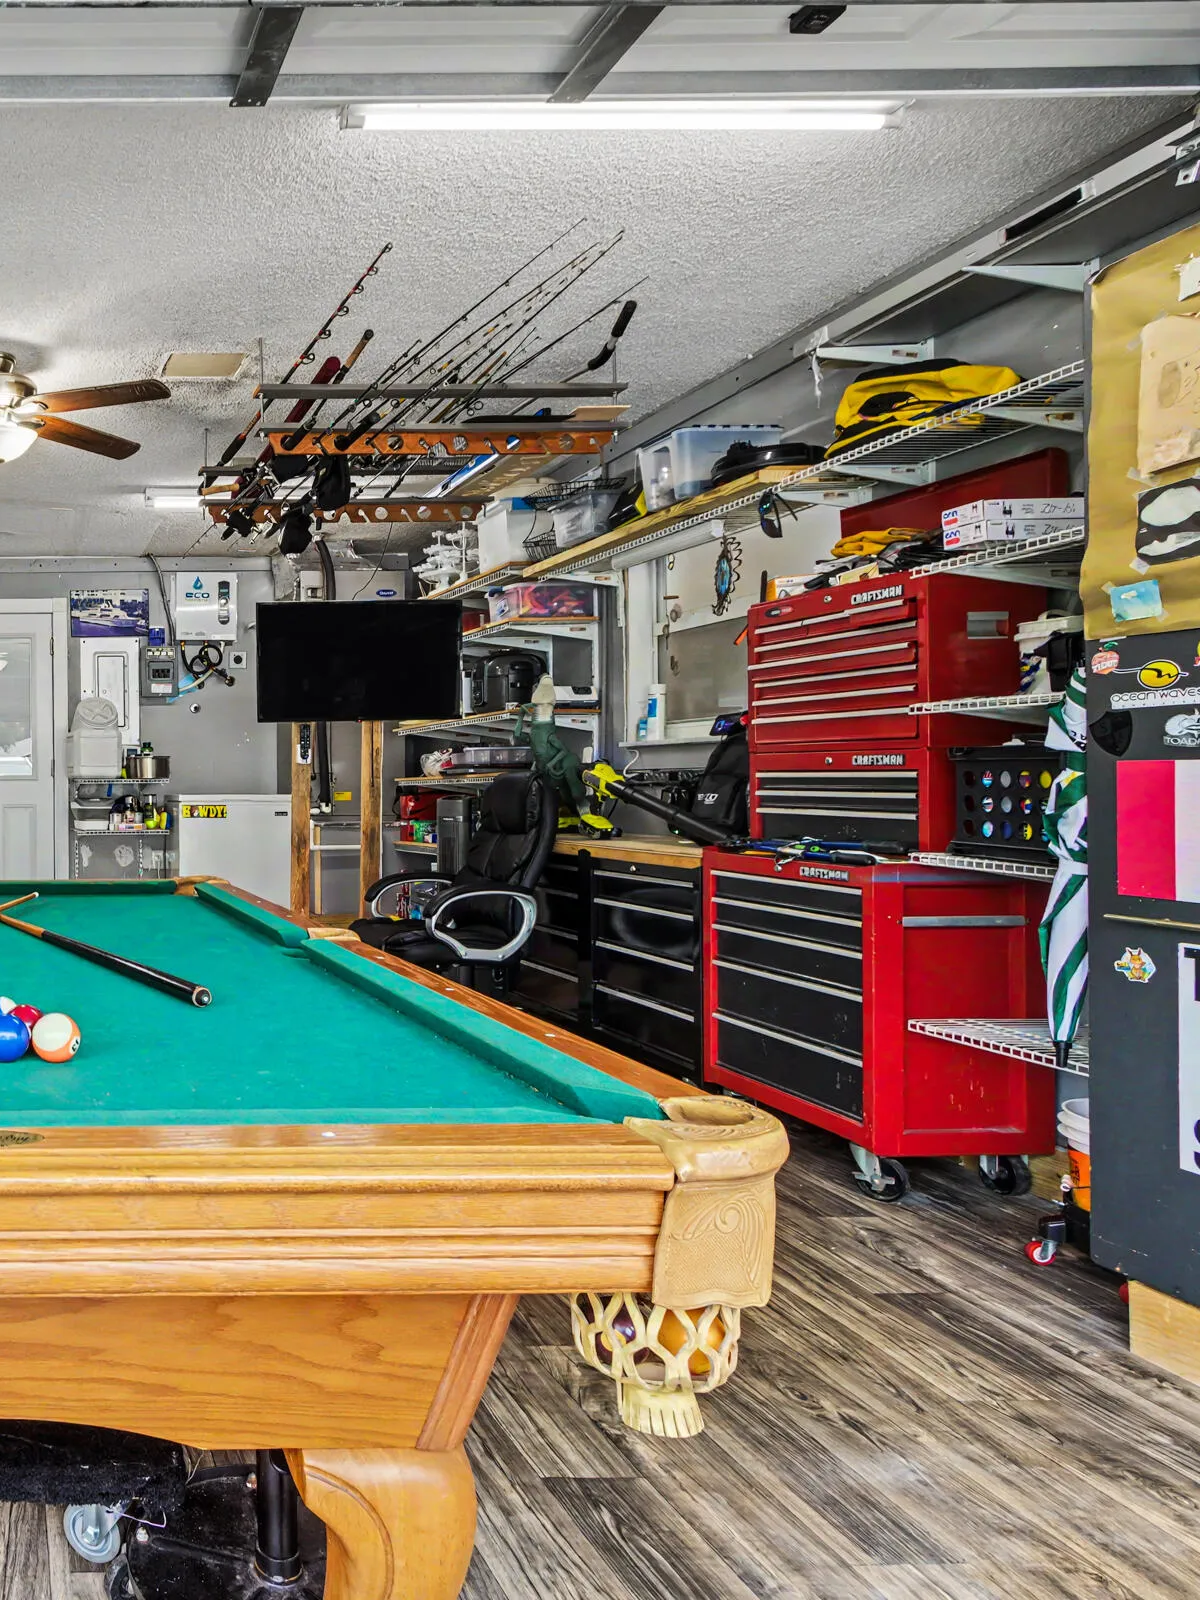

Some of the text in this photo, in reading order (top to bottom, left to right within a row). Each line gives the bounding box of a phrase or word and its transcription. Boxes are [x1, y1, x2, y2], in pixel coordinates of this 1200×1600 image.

[851, 584, 903, 605] CRAFTSMAN
[1111, 691, 1157, 703] ocean
[852, 754, 904, 766] CRAFTSMAN
[800, 866, 849, 881] CRAFTSMAN
